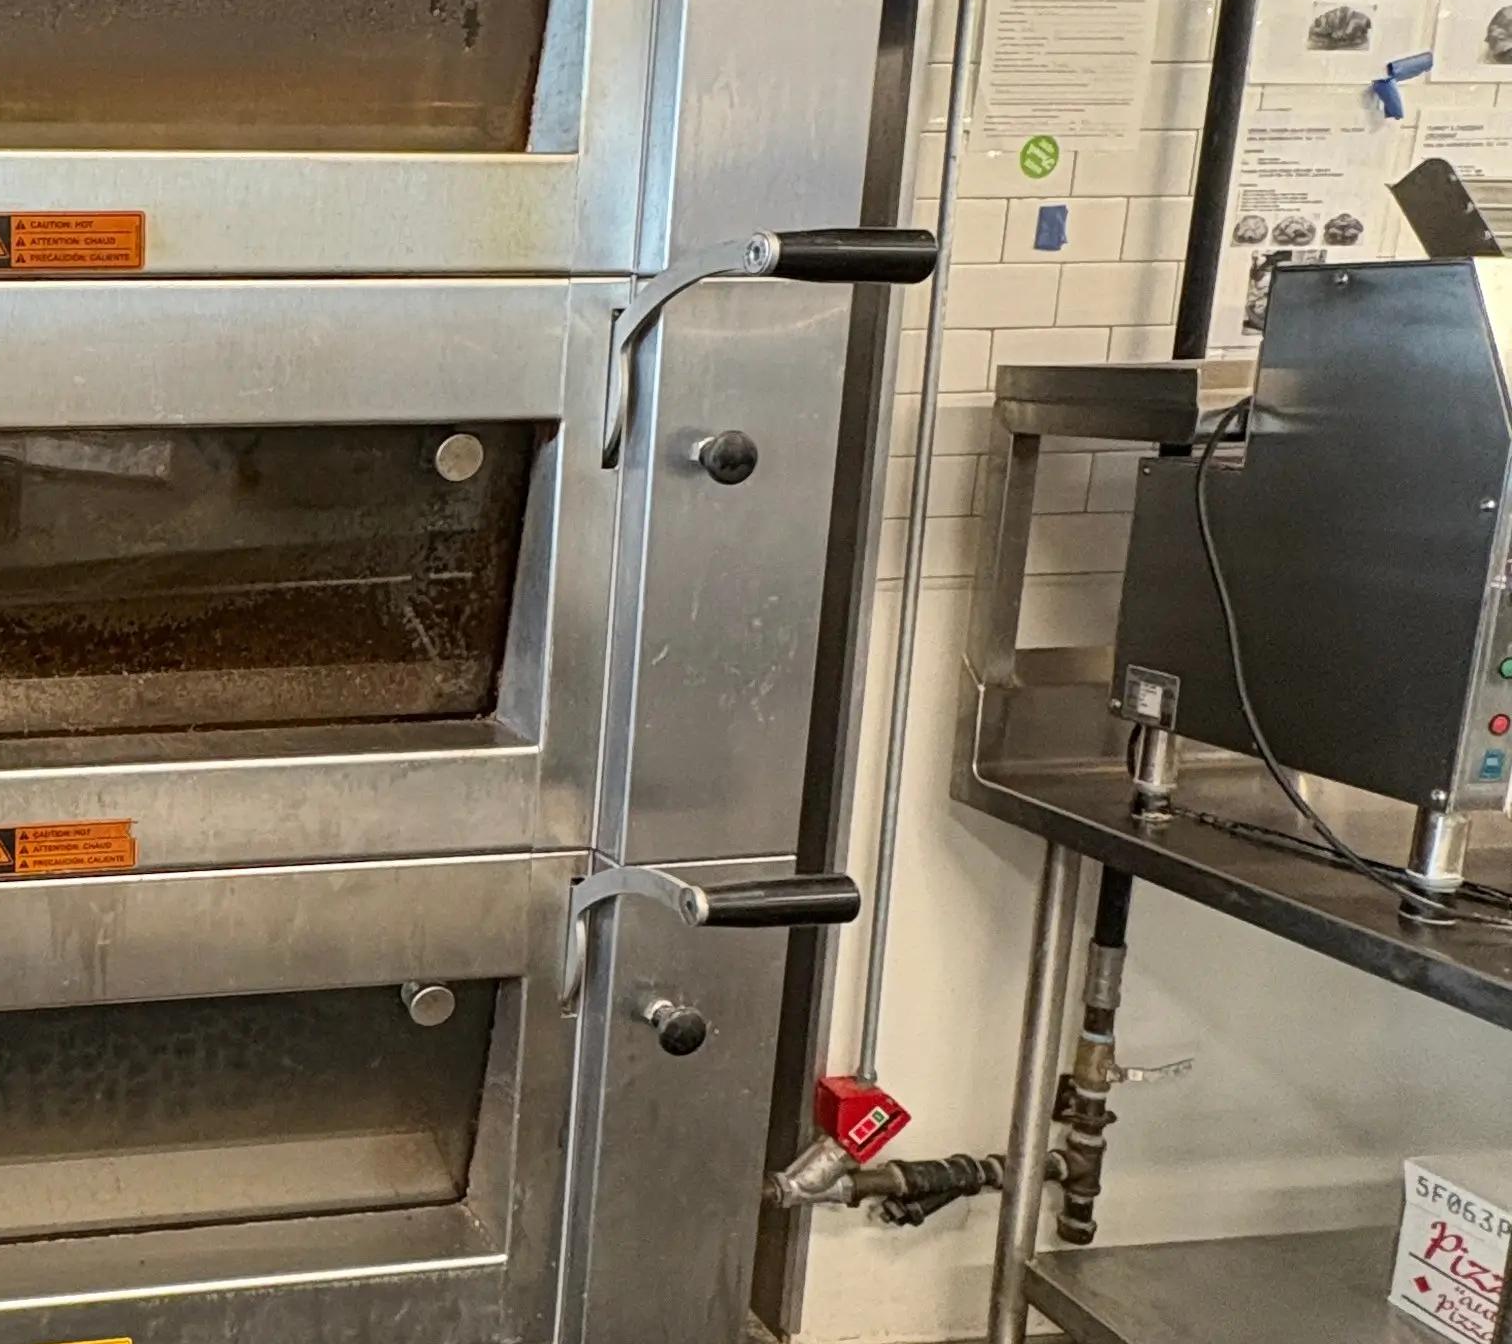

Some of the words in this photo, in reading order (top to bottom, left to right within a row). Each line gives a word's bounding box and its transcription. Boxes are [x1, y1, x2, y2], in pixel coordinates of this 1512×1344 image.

[74, 220, 94, 229] HOT
[84, 236, 116, 245] CHAUD
[83, 842, 112, 850] CHAUD
